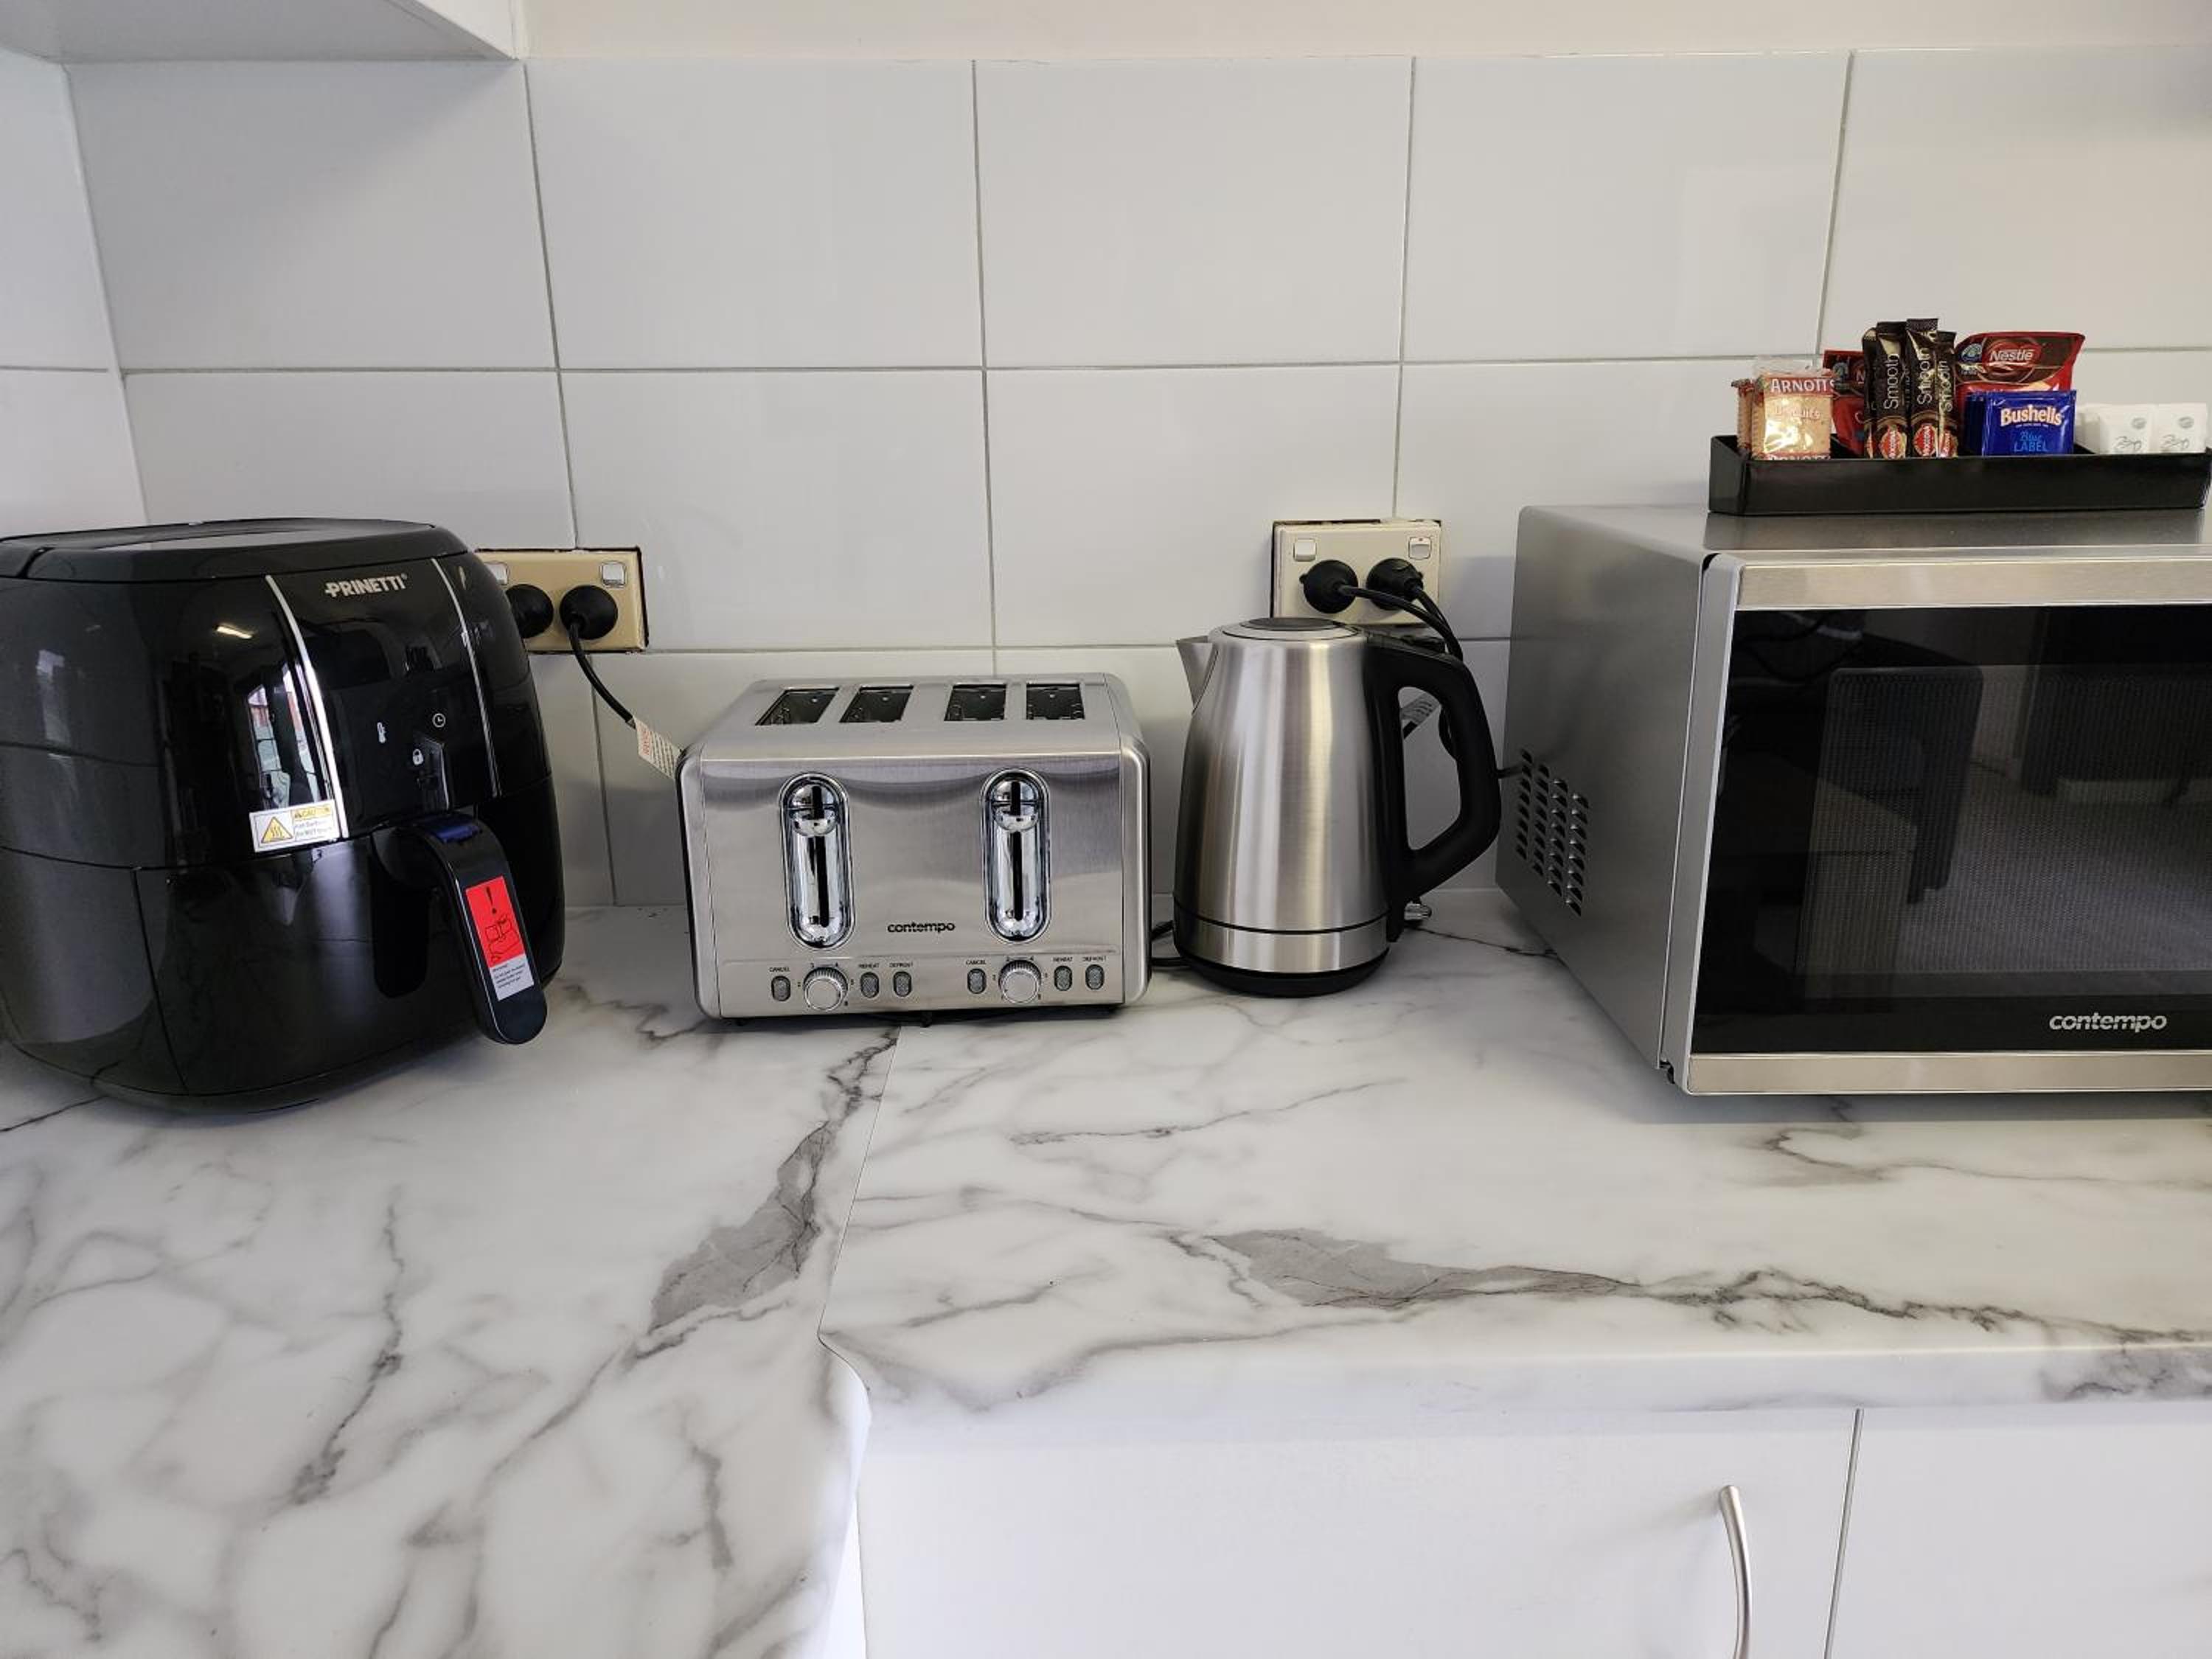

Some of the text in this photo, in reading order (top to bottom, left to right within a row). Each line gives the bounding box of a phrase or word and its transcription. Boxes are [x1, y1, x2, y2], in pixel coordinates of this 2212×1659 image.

[1883, 352, 1900, 409] Smooth
[1917, 347, 1933, 404] Smooth
[2000, 404, 2062, 427] Bushells
[2014, 441, 2048, 453] LABEL
[2020, 431, 2042, 442] Blue
[887, 922, 956, 933] contempo
[2049, 1012, 2167, 1033] contempo
